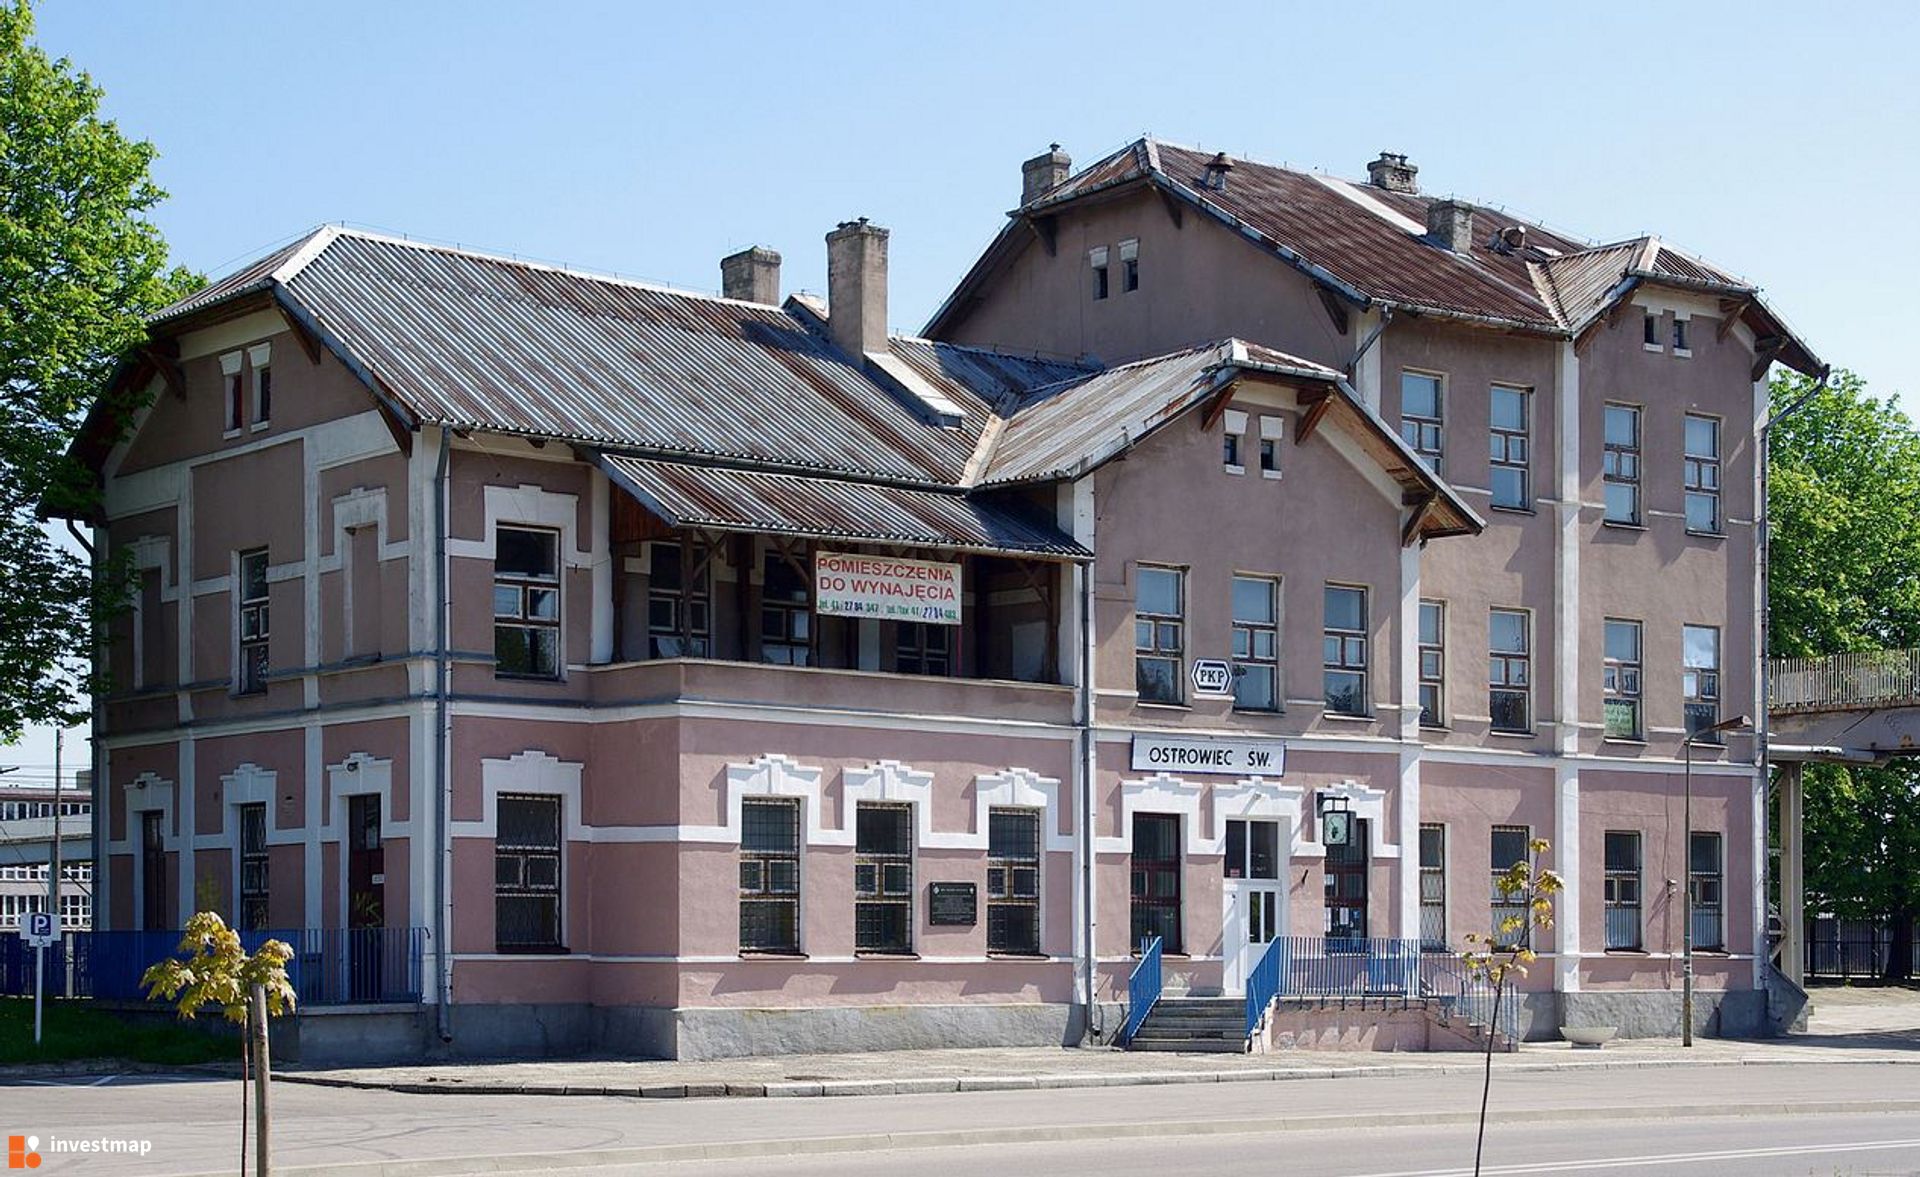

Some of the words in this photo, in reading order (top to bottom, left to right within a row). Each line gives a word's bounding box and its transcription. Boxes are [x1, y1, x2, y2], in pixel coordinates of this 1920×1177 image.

[817, 558, 955, 583] POMIESZCZENIA
[820, 576, 846, 592] DO
[851, 579, 955, 602] WYNAJĘCIA
[1200, 670, 1225, 683] PKP
[1149, 747, 1234, 766] OSTROWIEC
[1247, 746, 1271, 767] ŚW.
[34, 916, 47, 934] P
